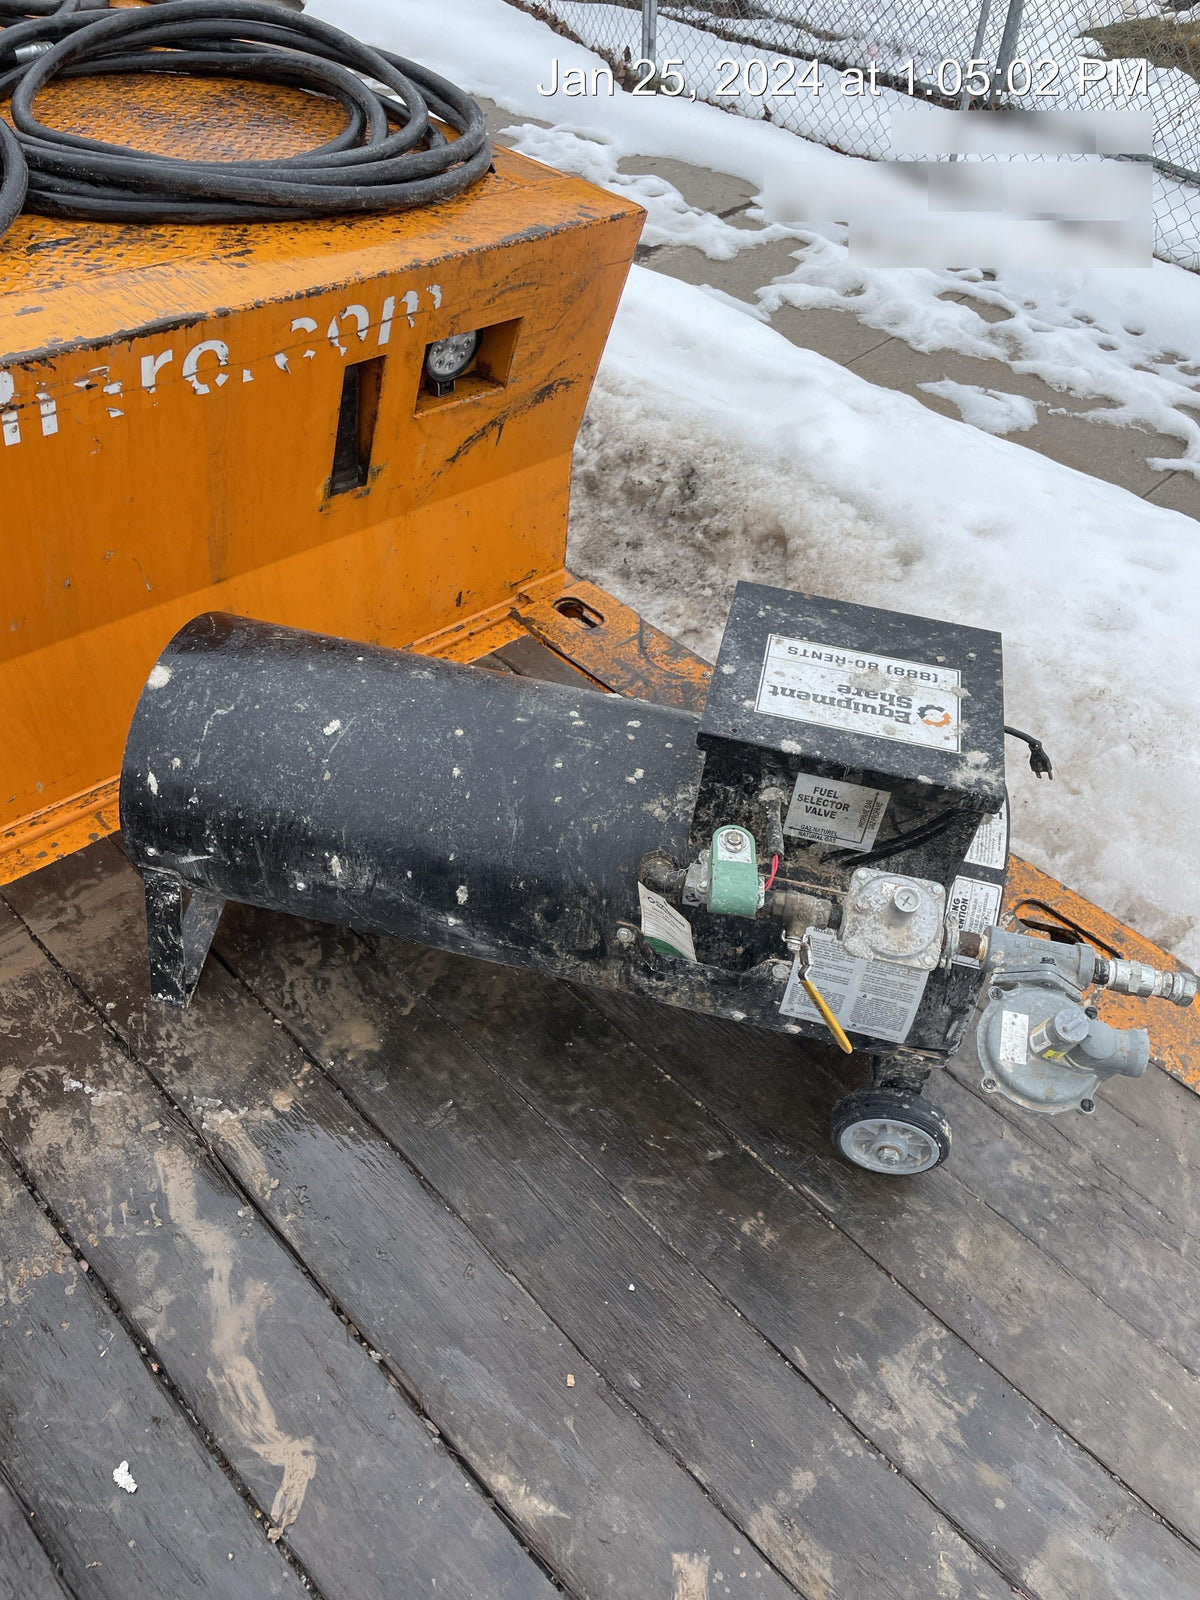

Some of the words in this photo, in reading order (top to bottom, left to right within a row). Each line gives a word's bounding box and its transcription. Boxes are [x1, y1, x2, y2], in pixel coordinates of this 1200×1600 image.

[787, 645, 880, 670] 80-RENTS
[886, 663, 938, 683] (888)
[768, 684, 912, 725] Equipment
[837, 683, 913, 710] Share
[797, 793, 850, 812] SELECTOR
[813, 786, 839, 799] FUEL
[805, 805, 837, 819] VALVE
